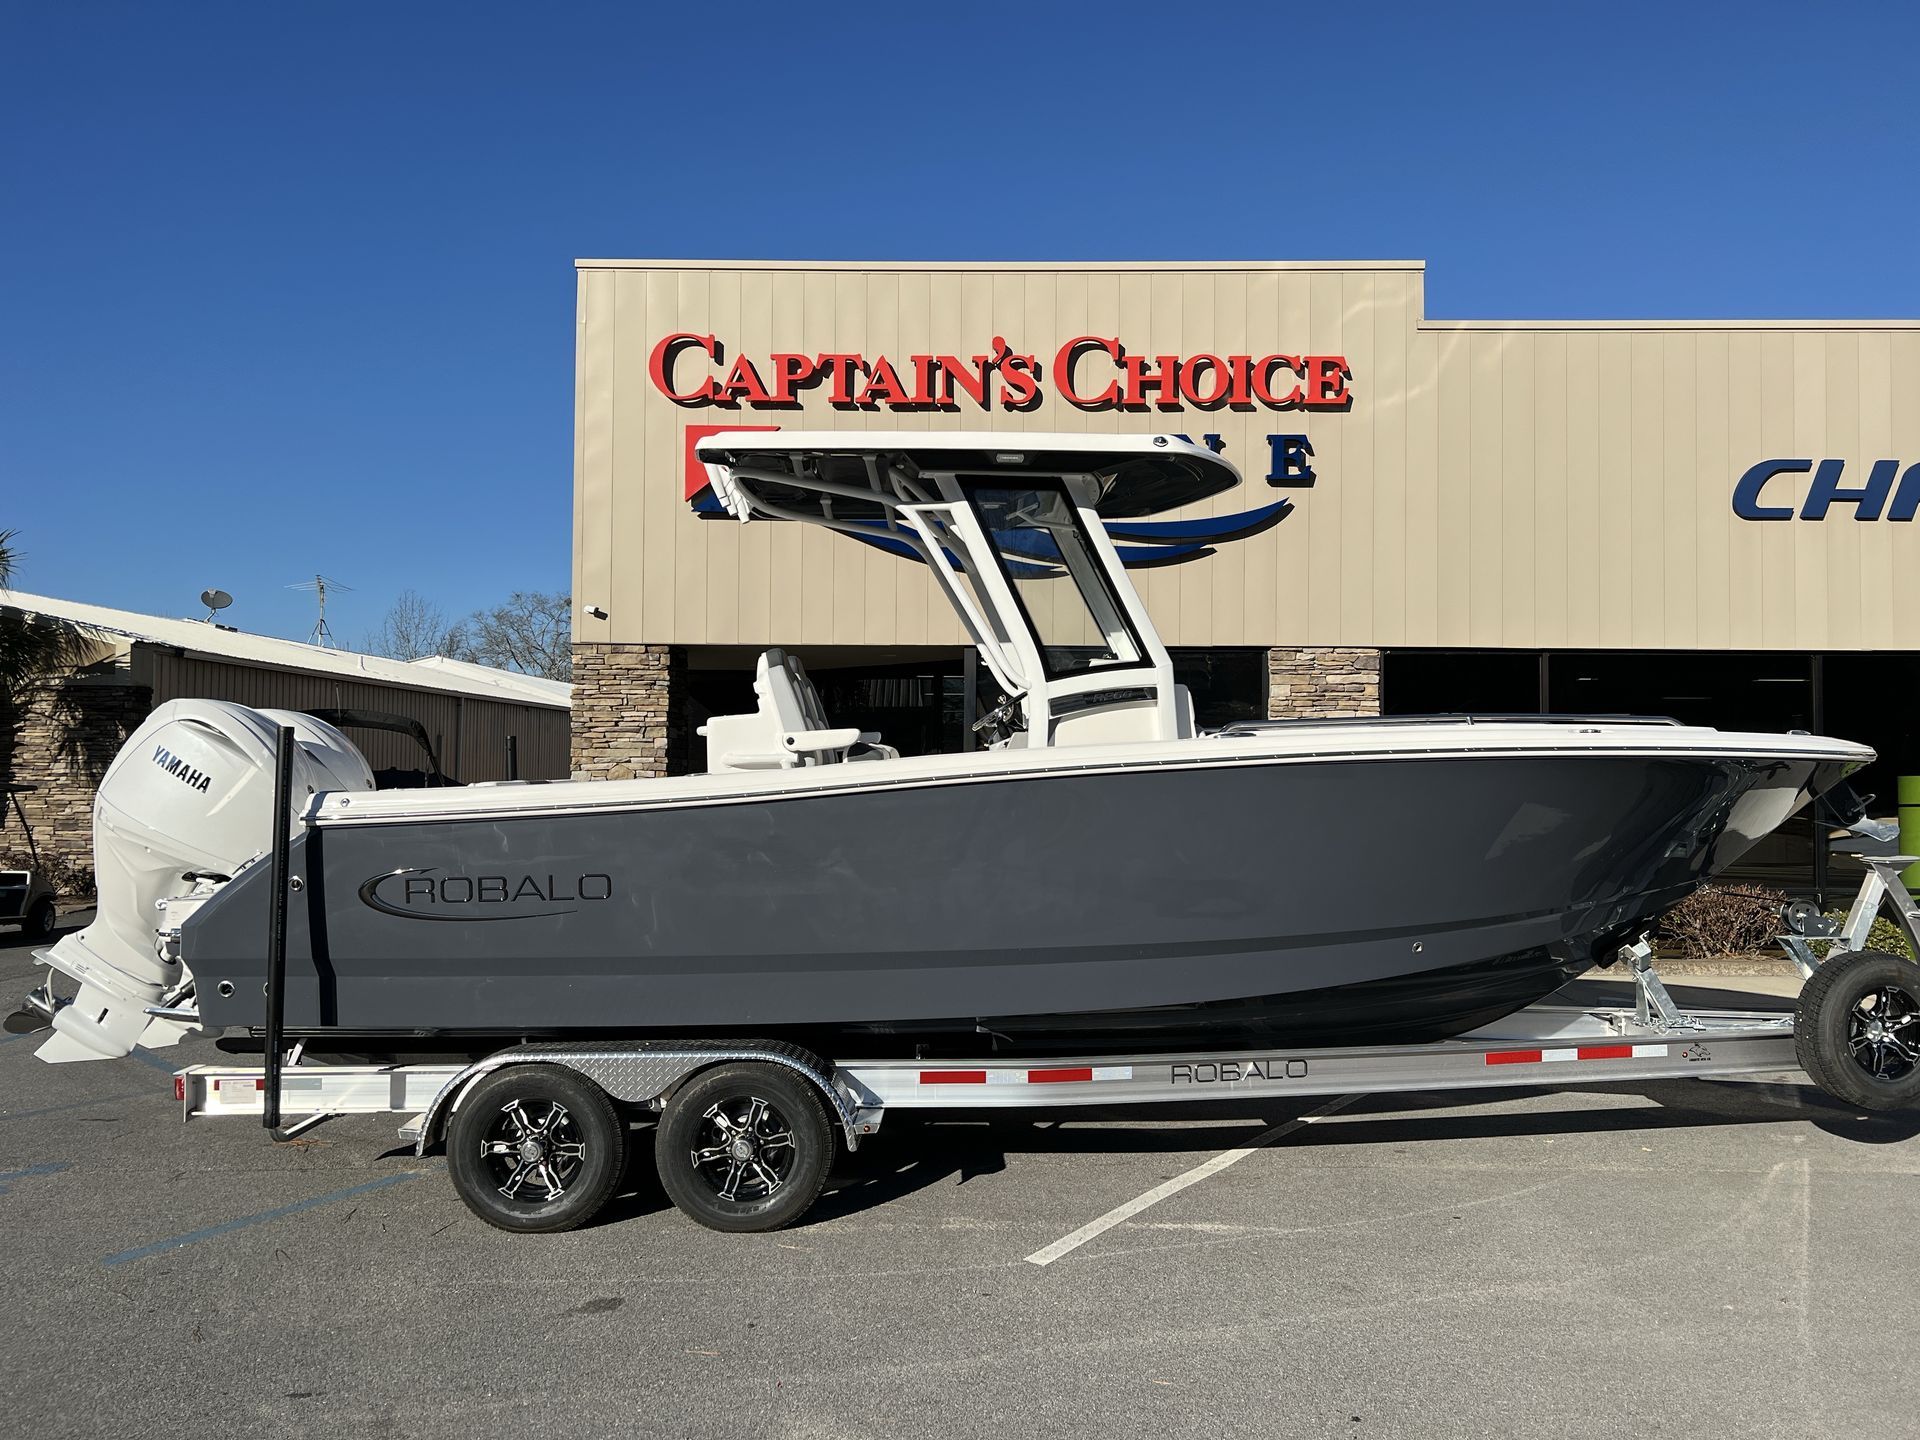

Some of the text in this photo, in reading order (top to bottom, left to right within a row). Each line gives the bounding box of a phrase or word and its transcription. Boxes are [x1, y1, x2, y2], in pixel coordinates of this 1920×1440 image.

[648, 332, 1351, 409] CAPTAIN'S CHOICE
[152, 744, 212, 794] YAMAHA
[404, 873, 612, 904] ROBALO
[1170, 1058, 1308, 1084] ROBALO
